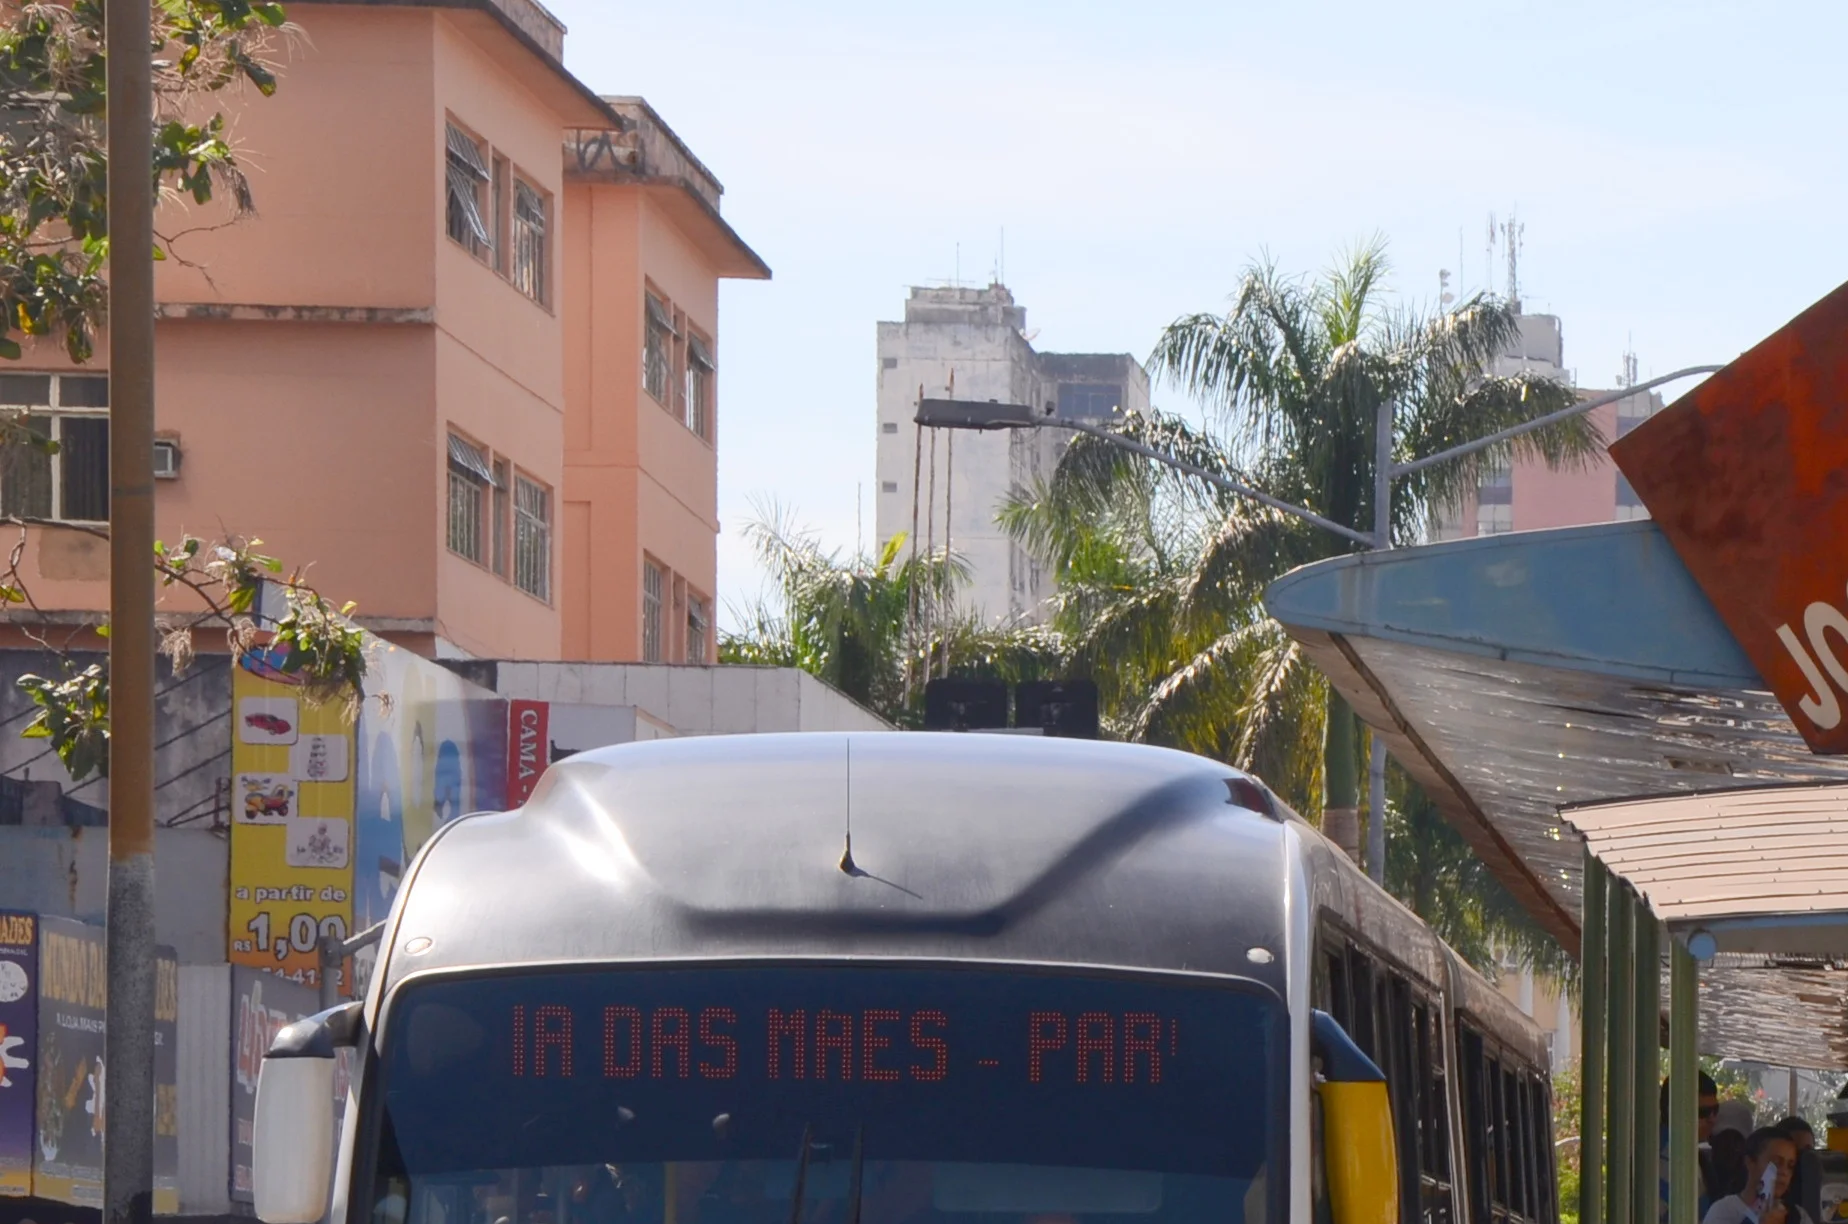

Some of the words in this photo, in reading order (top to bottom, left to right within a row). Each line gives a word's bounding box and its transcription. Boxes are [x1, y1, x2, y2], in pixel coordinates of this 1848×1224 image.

[520, 709, 538, 779] CAMA
[235, 886, 249, 899] a
[255, 884, 314, 904] partir
[319, 885, 347, 902] de
[247, 910, 348, 961] 1,00
[603, 1005, 737, 1079] DAS
[766, 1007, 949, 1082] MAES
